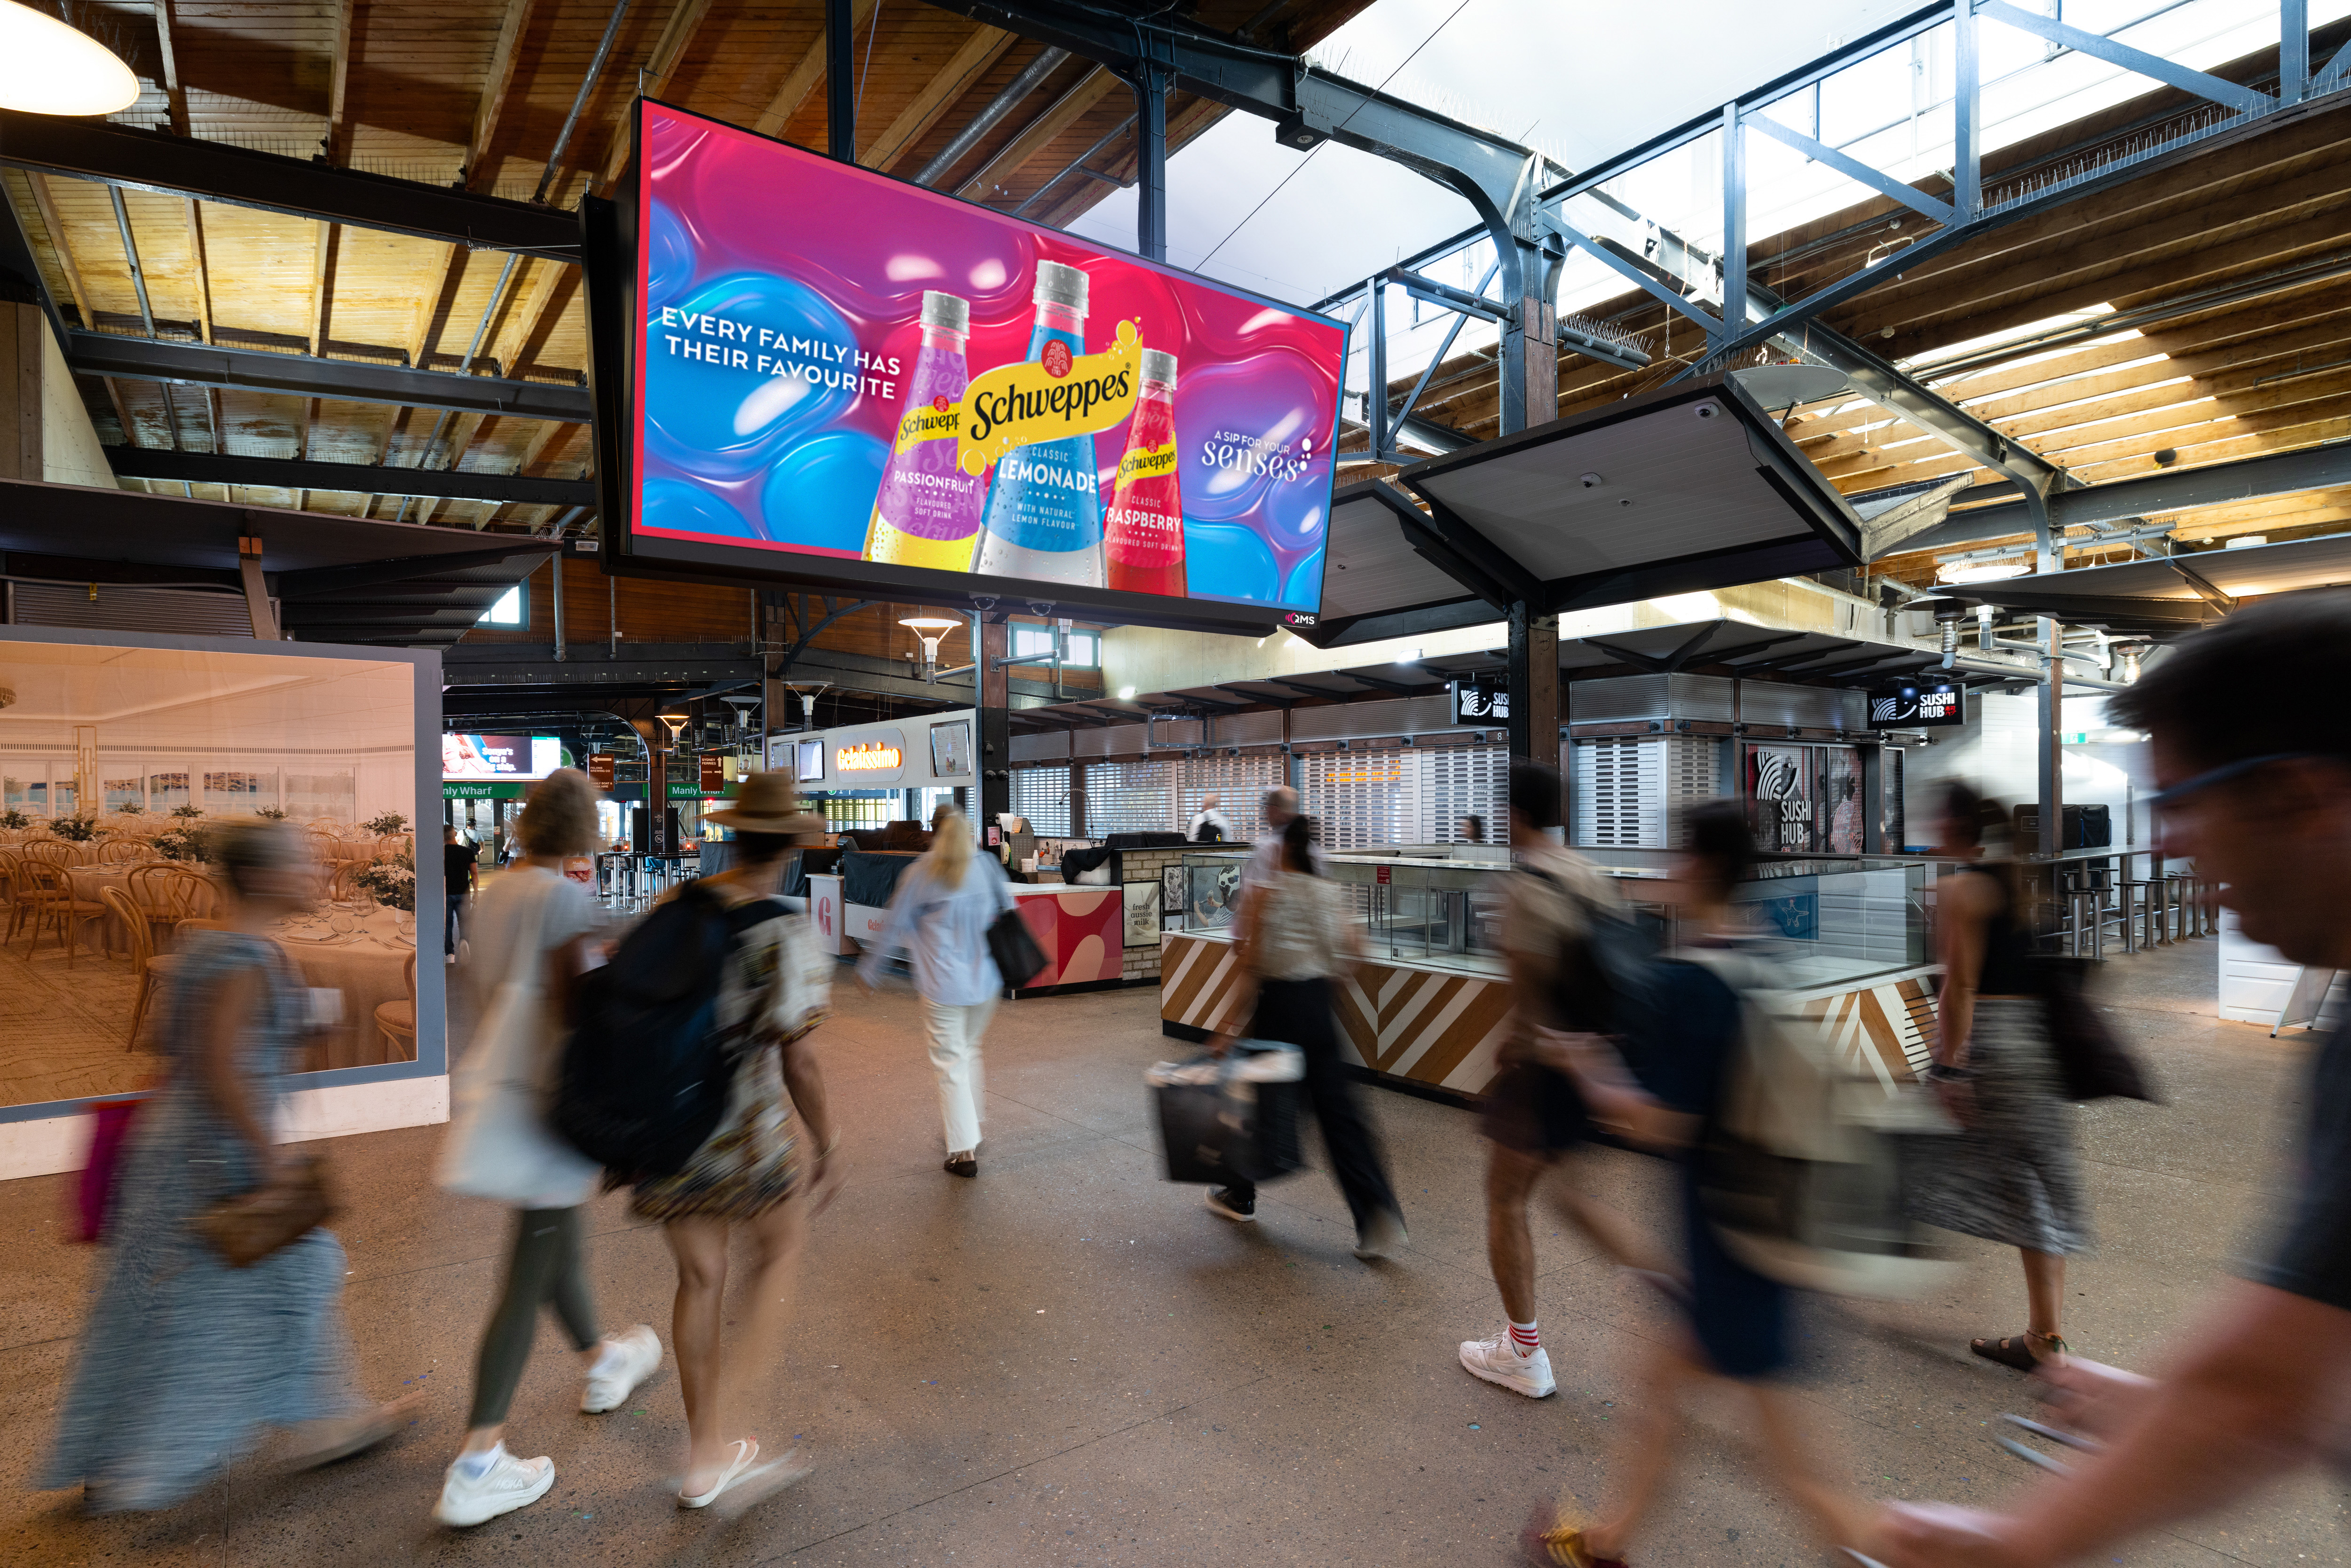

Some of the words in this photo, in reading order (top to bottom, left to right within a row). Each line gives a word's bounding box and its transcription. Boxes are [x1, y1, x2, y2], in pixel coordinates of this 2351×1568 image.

[663, 306, 753, 342] EVERY
[760, 328, 848, 363] FAMILY
[854, 349, 900, 375] HAS
[665, 334, 749, 370] THEIR
[757, 355, 895, 399] FAVOURITE
[970, 370, 1129, 441] Schweppes
[900, 413, 960, 441] Schwepp
[1214, 430, 1222, 440] A
[1223, 432, 1240, 443] SIP
[1242, 435, 1262, 449] FOR
[1264, 441, 1290, 455] YOUR
[1032, 447, 1068, 462] CLASSIC
[1202, 441, 1298, 482] senses
[1119, 449, 1176, 479] Schweppes
[894, 471, 974, 494] PASSIONFRUIT
[998, 458, 1097, 494] LEMONADE
[916, 497, 952, 509] FLAVOURED
[1131, 496, 1161, 508] CLASSIC
[915, 507, 931, 516] SOFT
[933, 510, 952, 520] DRINK
[1017, 503, 1036, 512] WITH
[1040, 506, 1073, 519] NATURAL
[1012, 514, 1038, 525] LEMON
[1041, 518, 1075, 530] FLAVOUR
[1106, 507, 1181, 532] RASPBERRY
[1105, 536, 1140, 546] FLAVOURED
[1143, 541, 1159, 549] SOFT
[1290, 613, 1315, 625] QMS
[1493, 692, 1509, 705] SUS
[1920, 693, 1955, 706] SUSHI
[1493, 705, 1509, 718] HUB
[1919, 706, 1945, 718] HUB
[1497, 732, 1502, 741] 8
[482, 747, 513, 756] Sonya's
[837, 742, 901, 771] Gelatissimo
[496, 763, 516, 772] ship.
[443, 787, 458, 796] nly
[672, 787, 697, 796] Manly
[1781, 800, 1811, 822] SUSHI
[1781, 823, 1804, 844] HUB
[818, 897, 831, 936] G
[495, 1477, 523, 1490] HOKA
